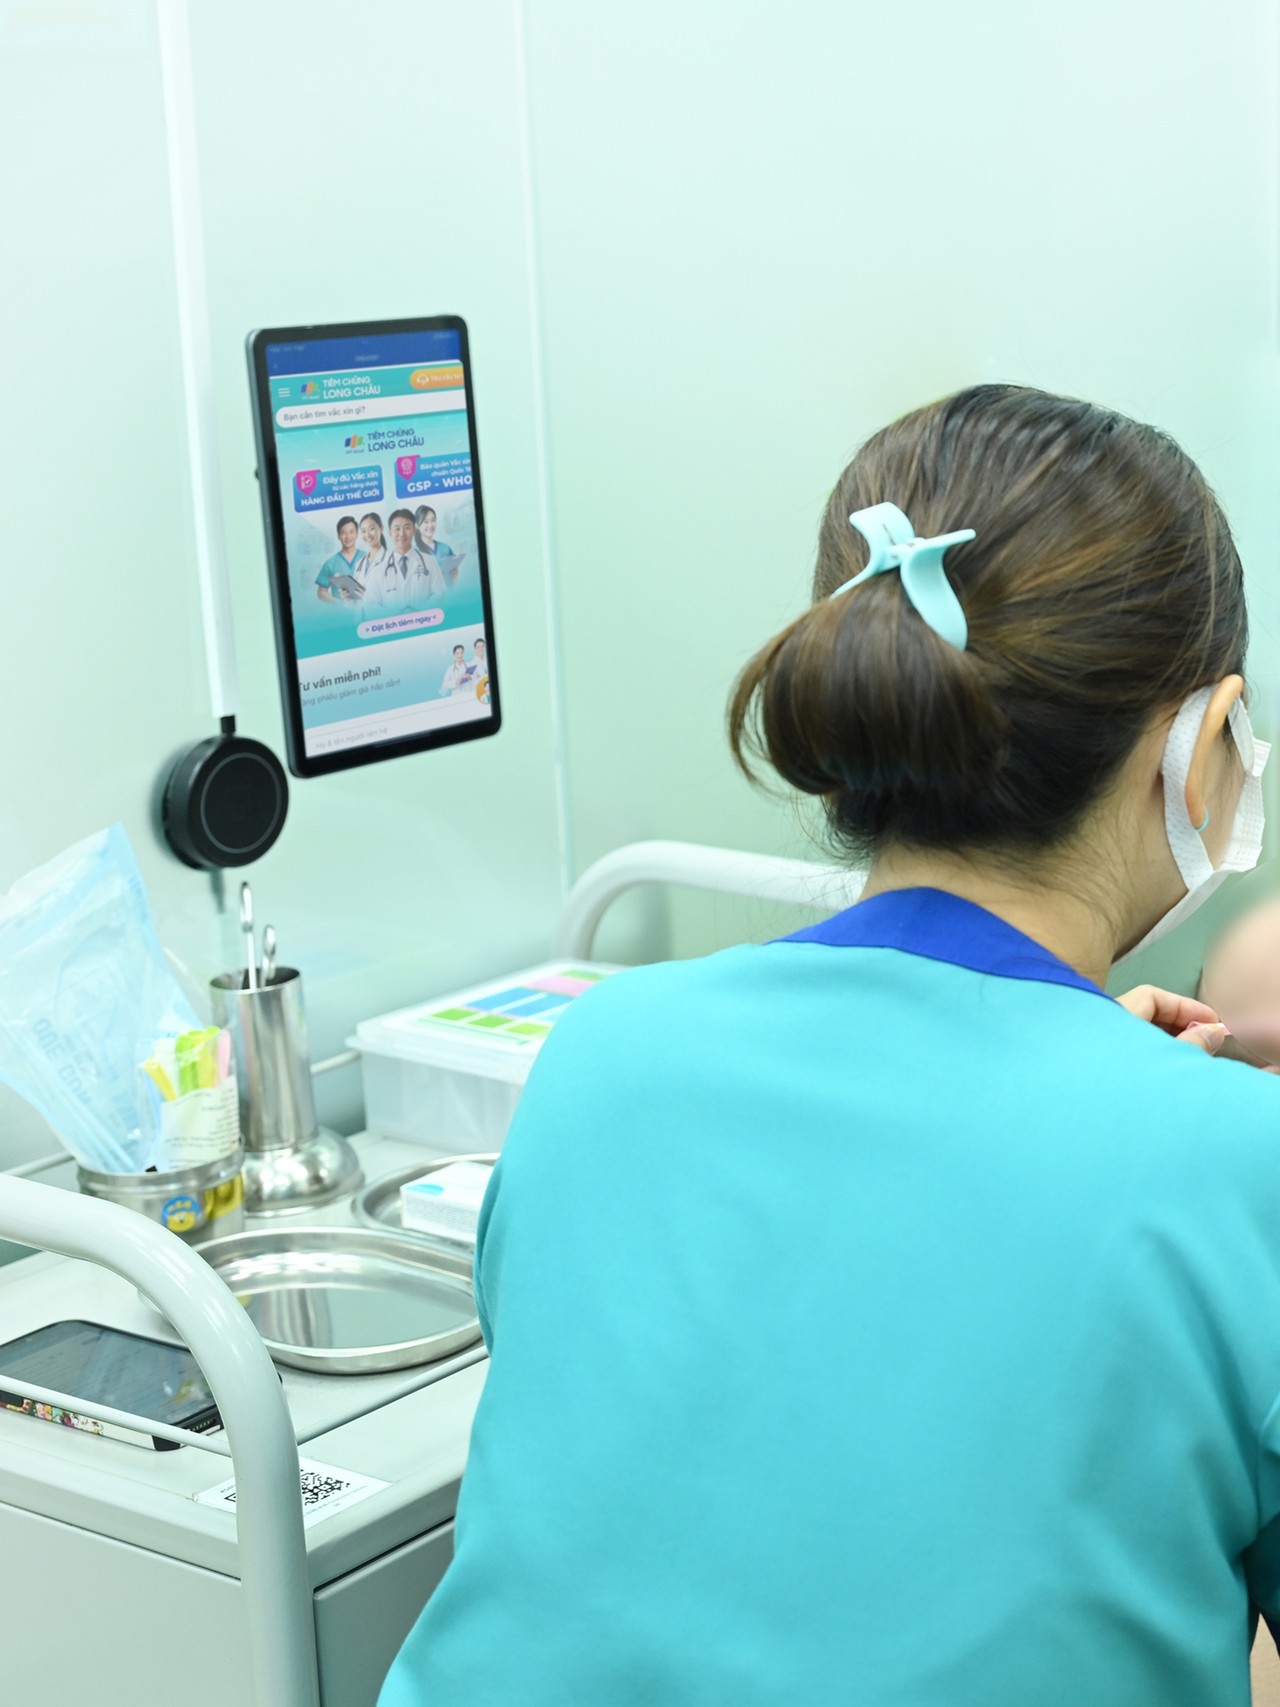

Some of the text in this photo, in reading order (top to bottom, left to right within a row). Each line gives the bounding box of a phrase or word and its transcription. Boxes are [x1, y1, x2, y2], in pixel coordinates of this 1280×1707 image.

[322, 378, 341, 388] TIÊM
[323, 383, 381, 400] LONG CHÂU
[283, 412, 299, 422] Bạn
[299, 409, 314, 420] cần
[328, 406, 341, 417] vắc
[342, 407, 354, 416] xin
[367, 430, 386, 441] TIÊM
[368, 441, 396, 452] LONG
[397, 435, 425, 449] CHÂU
[407, 480, 431, 493] GSP
[442, 474, 472, 488] WHO
[301, 494, 325, 507] HÀNG
[371, 623, 384, 633] Đặt
[415, 615, 432, 625] ngay
[313, 675, 332, 689] vấn
[334, 670, 361, 685] miễn
[362, 666, 381, 682] phí!
